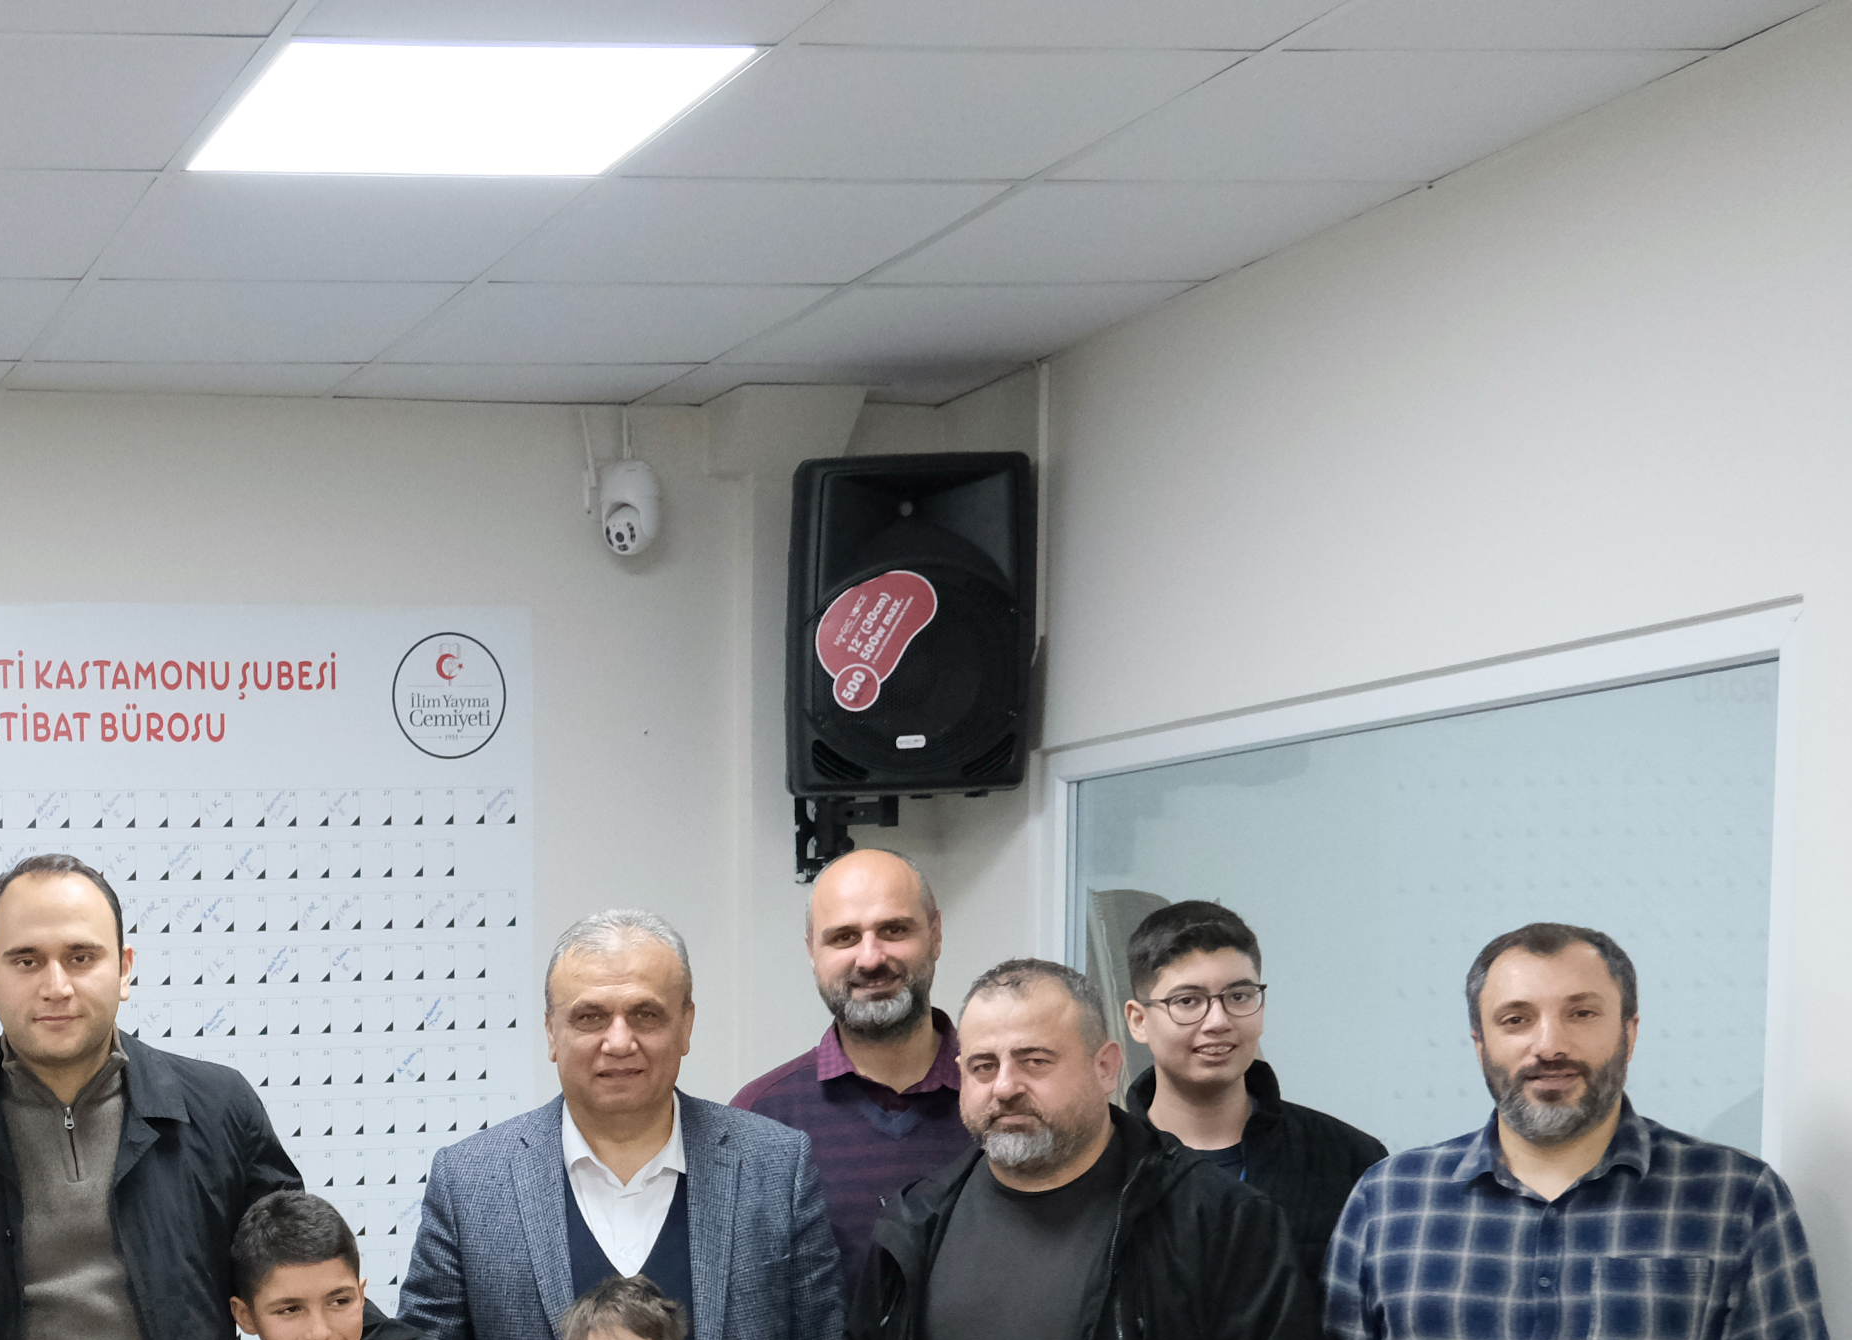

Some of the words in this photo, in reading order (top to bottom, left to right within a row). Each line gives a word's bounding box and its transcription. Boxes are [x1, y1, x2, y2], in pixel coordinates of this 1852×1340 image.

[860, 592, 891, 635] (30cm)
[35, 659, 231, 691] KASTAMONU
[238, 651, 337, 700] ŞUBESİ
[841, 670, 866, 701] 500
[410, 692, 441, 708] İlim
[442, 694, 490, 713] Yayma
[101, 703, 226, 743] BÜROSU
[409, 709, 491, 733] Cemiyeti
